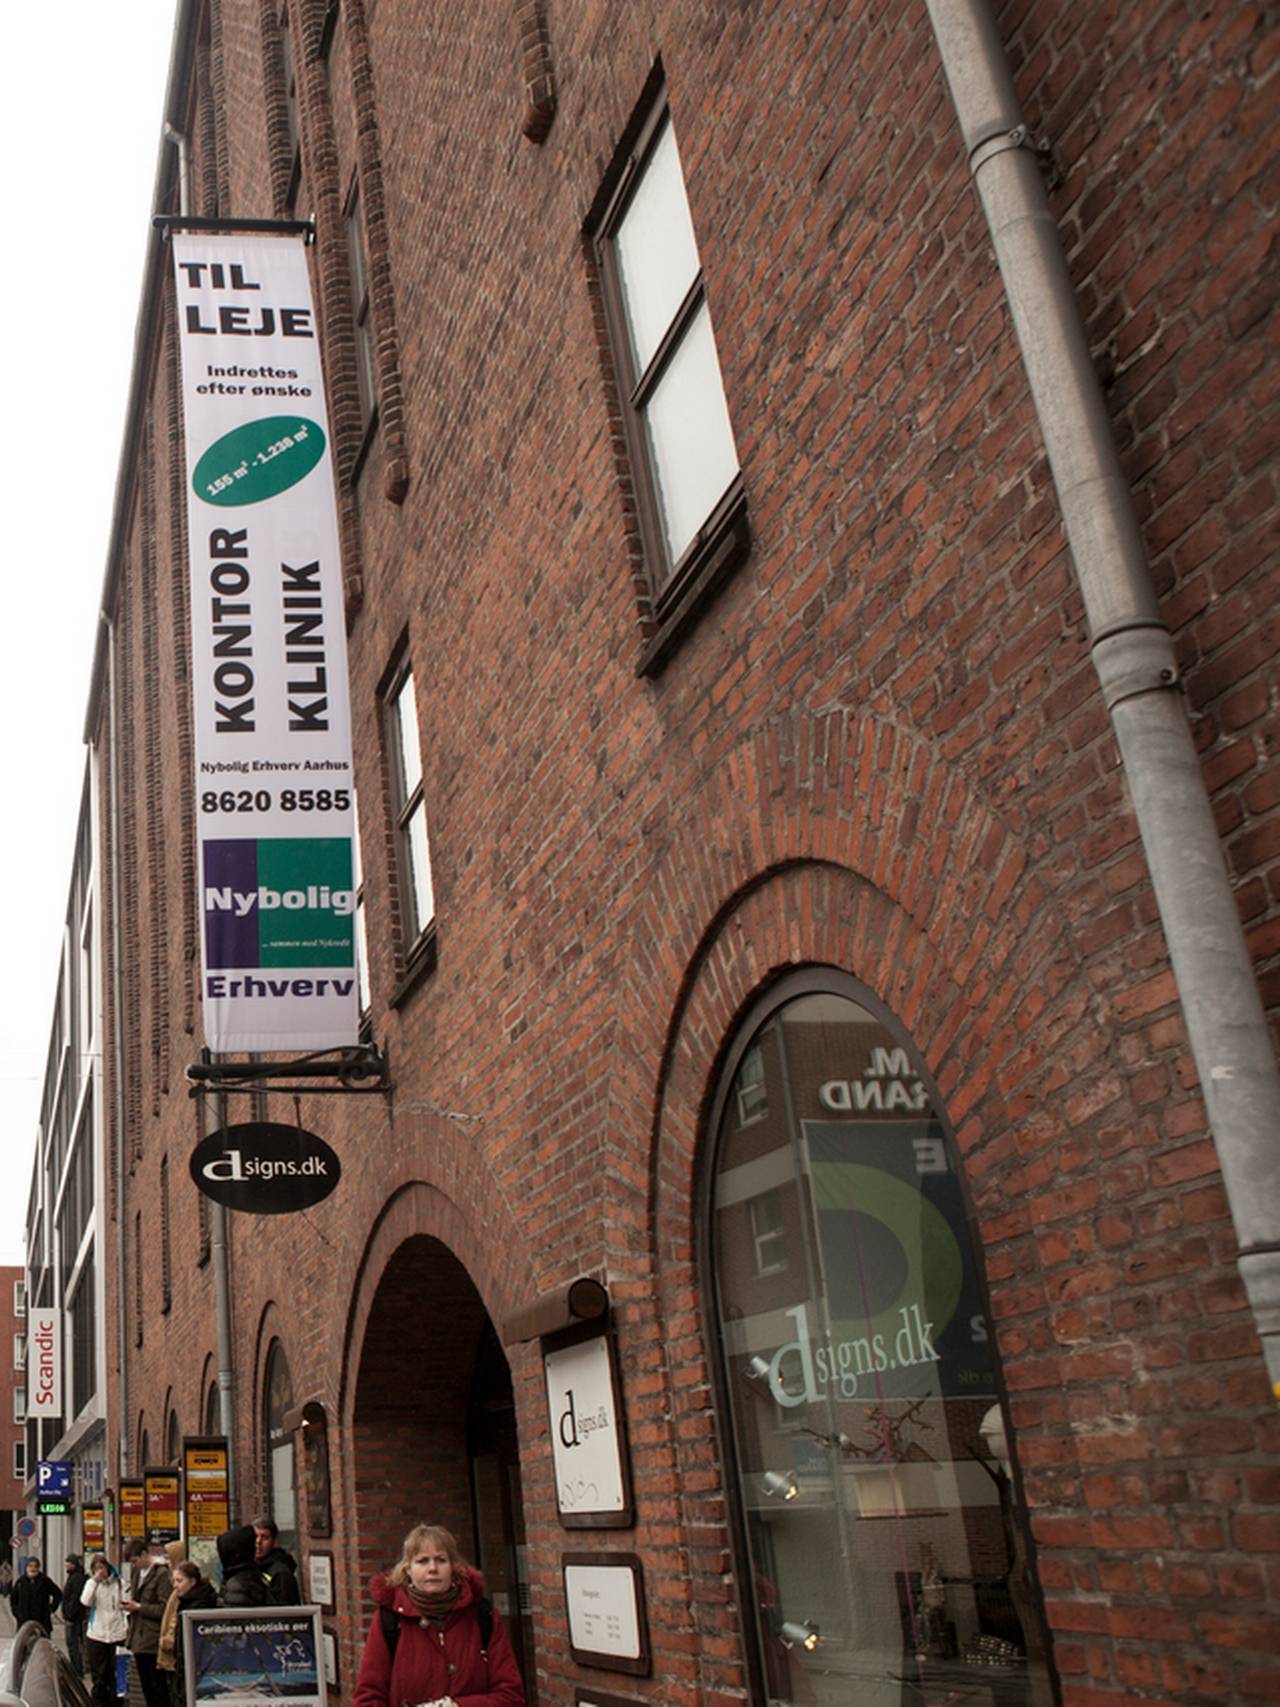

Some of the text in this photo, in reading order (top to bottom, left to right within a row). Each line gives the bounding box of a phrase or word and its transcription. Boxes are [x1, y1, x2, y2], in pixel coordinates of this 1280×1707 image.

[179, 263, 261, 290] TIL
[186, 305, 314, 338] LEJE
[207, 365, 298, 379] Indrettes
[196, 382, 312, 397] efter ønske
[210, 528, 256, 733] KONTOR
[281, 560, 329, 732] KLINIK
[201, 760, 349, 773] Nybolig Erhverv Aarhus
[201, 790, 351, 813] 8620 8585
[205, 886, 356, 916] Nybolig
[207, 976, 354, 998] Erhverv
[202, 1150, 327, 1181] dsigns.dk
[35, 1320, 54, 1404] Scandic
[769, 1304, 941, 1408] dsigns.dk
[39, 1467, 52, 1487] P
[198, 1624, 243, 1635] Caribiens
